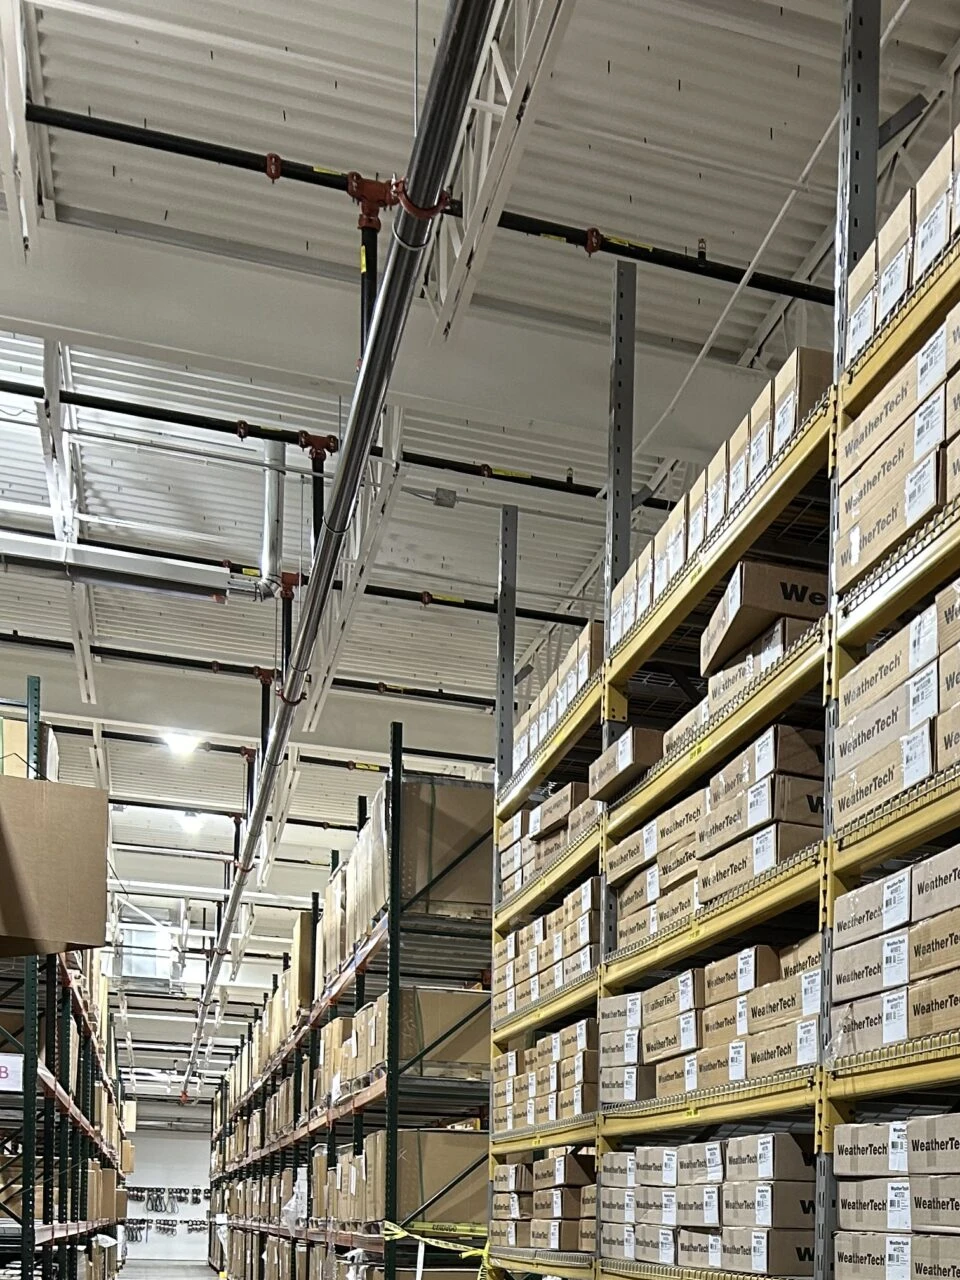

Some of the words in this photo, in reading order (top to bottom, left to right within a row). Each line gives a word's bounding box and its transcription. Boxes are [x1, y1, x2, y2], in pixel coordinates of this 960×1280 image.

[844, 388, 908, 458] WeatherTech
[843, 656, 901, 707] WeatherTech
[839, 712, 899, 757] WeatherTech
[838, 770, 895, 812] WeatherTech
[836, 962, 881, 985] WeatherTech
[751, 994, 796, 1018] WeatherTech
[751, 1042, 792, 1065] WeatherTech
[837, 1144, 888, 1156] WeatherTech
[841, 1199, 887, 1211] WeatherTech
[837, 1251, 885, 1266] WeatherTech
